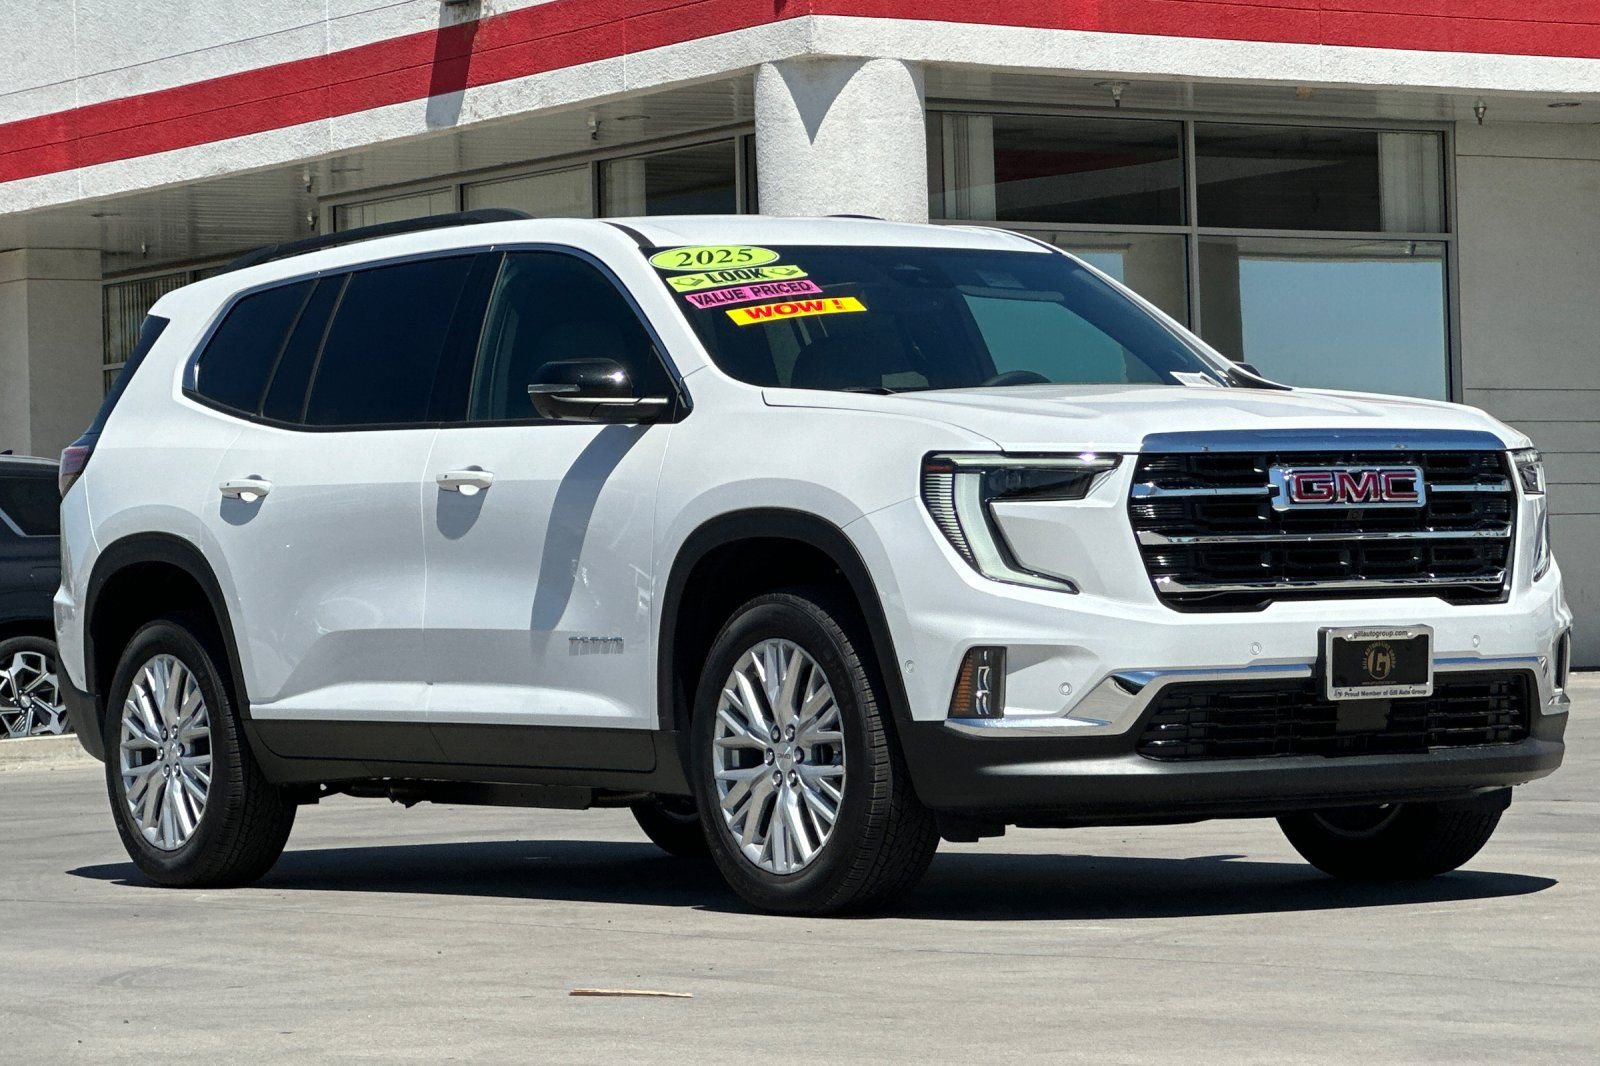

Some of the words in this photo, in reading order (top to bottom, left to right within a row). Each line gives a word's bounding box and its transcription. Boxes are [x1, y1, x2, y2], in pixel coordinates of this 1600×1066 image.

[675, 248, 753, 267] 2025
[704, 268, 765, 284] LOOK
[692, 288, 747, 305] VALUE
[752, 281, 812, 297] PRICED
[744, 300, 823, 319] WOW
[1290, 471, 1418, 502] GMC
[1354, 630, 1408, 639] gillautogroup.com
